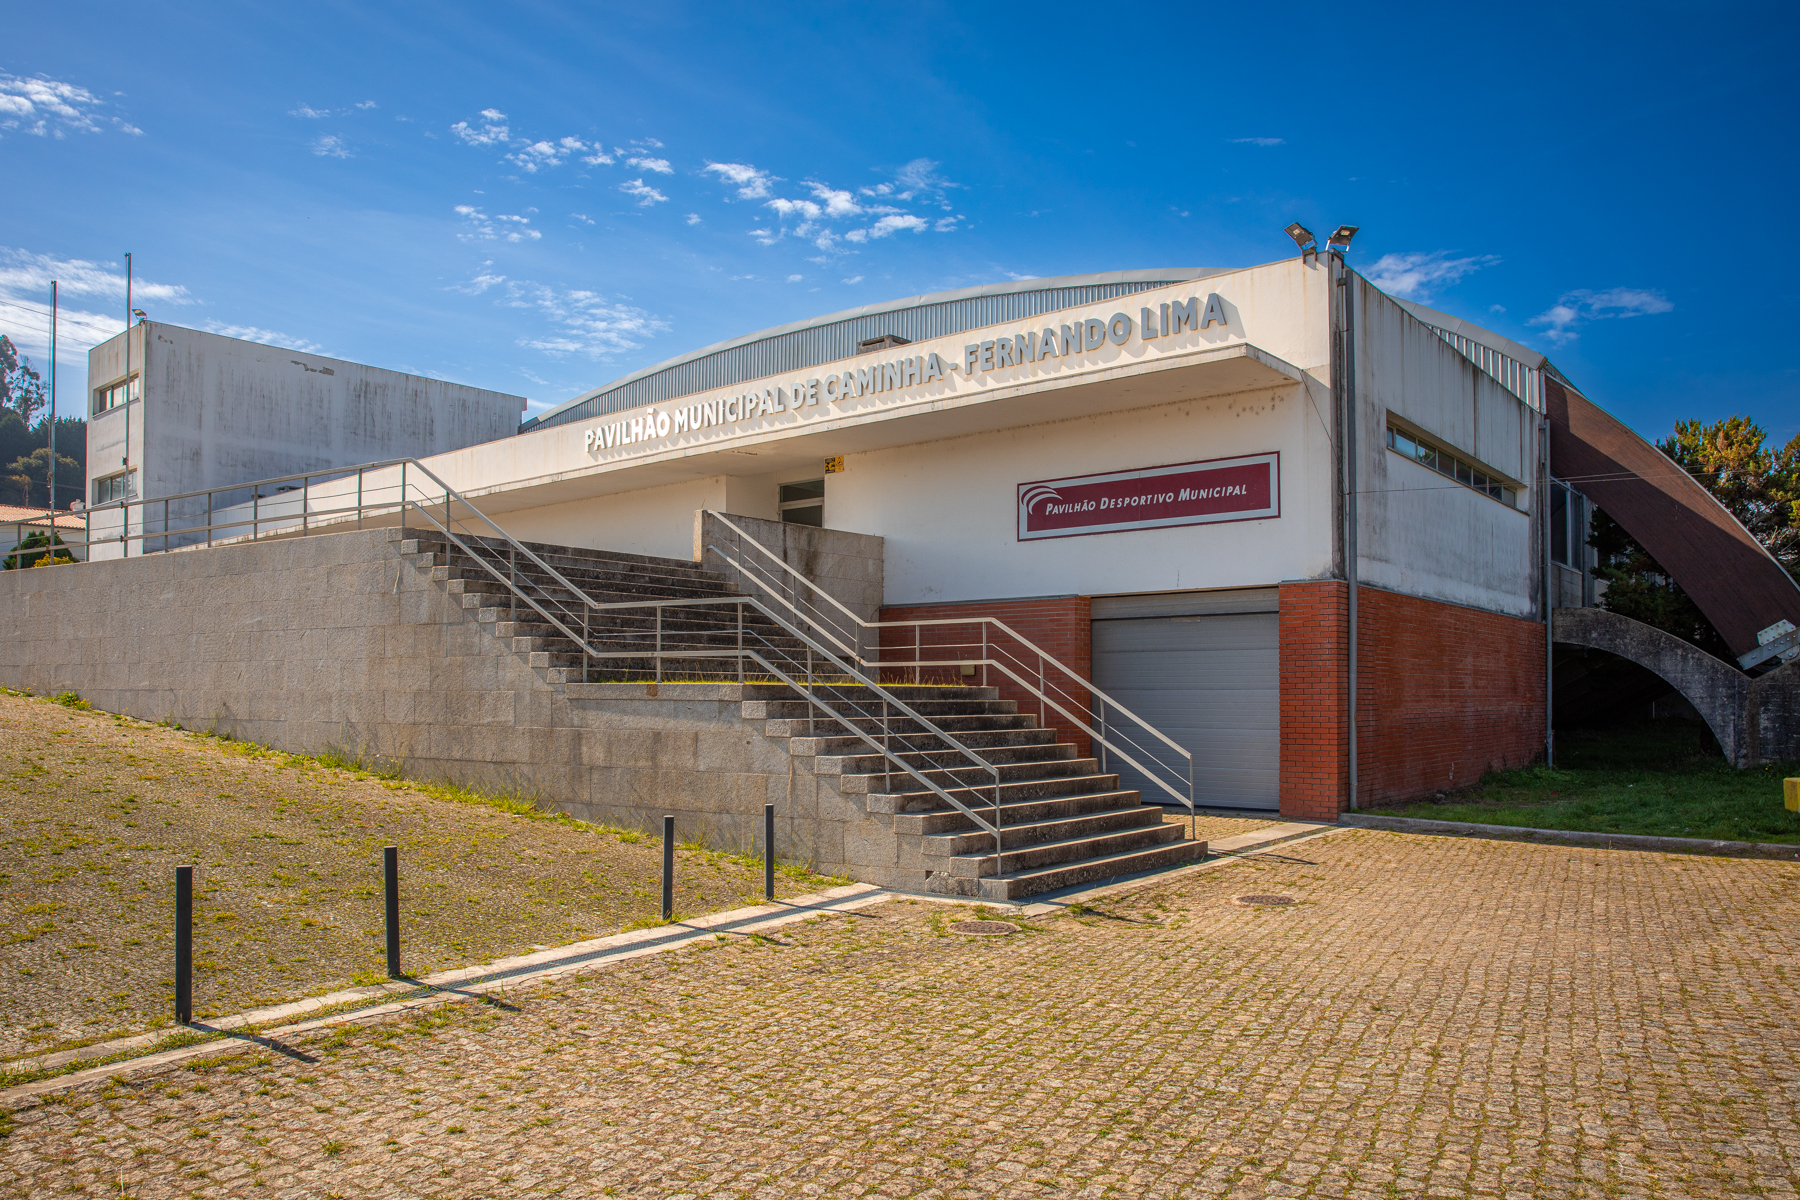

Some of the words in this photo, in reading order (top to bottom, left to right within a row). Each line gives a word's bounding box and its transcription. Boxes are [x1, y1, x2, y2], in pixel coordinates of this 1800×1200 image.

[584, 408, 671, 453] PAVILHÃO
[674, 386, 786, 434] MUNICIPAL
[790, 378, 819, 410] DE
[823, 352, 944, 402] CAMINHA
[964, 312, 1133, 376] FERNANDO
[1140, 293, 1228, 340] LIMA
